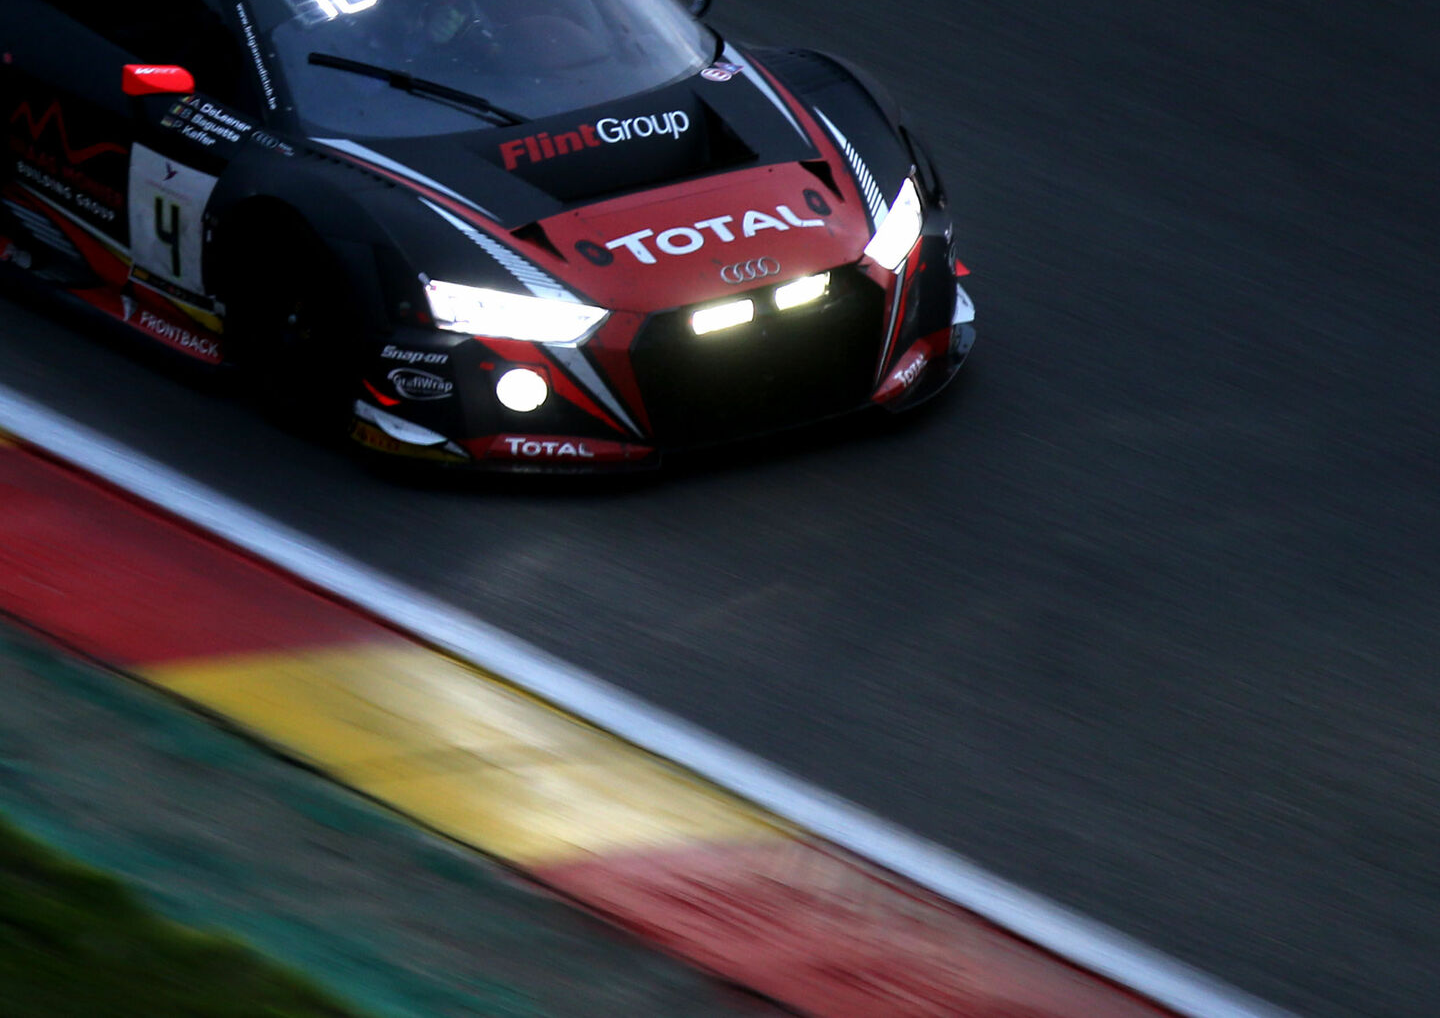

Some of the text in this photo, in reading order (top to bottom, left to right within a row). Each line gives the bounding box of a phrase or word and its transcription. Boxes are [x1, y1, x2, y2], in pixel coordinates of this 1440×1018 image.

[15, 159, 73, 201] BUILDING
[74, 192, 117, 222] GROUP
[155, 196, 181, 279] 4
[604, 204, 826, 266] TOTAL
[139, 309, 220, 359] FRONTBACK
[380, 344, 450, 365] Snap-on
[893, 352, 929, 388] TOTAL
[504, 437, 596, 459] TOTAL
